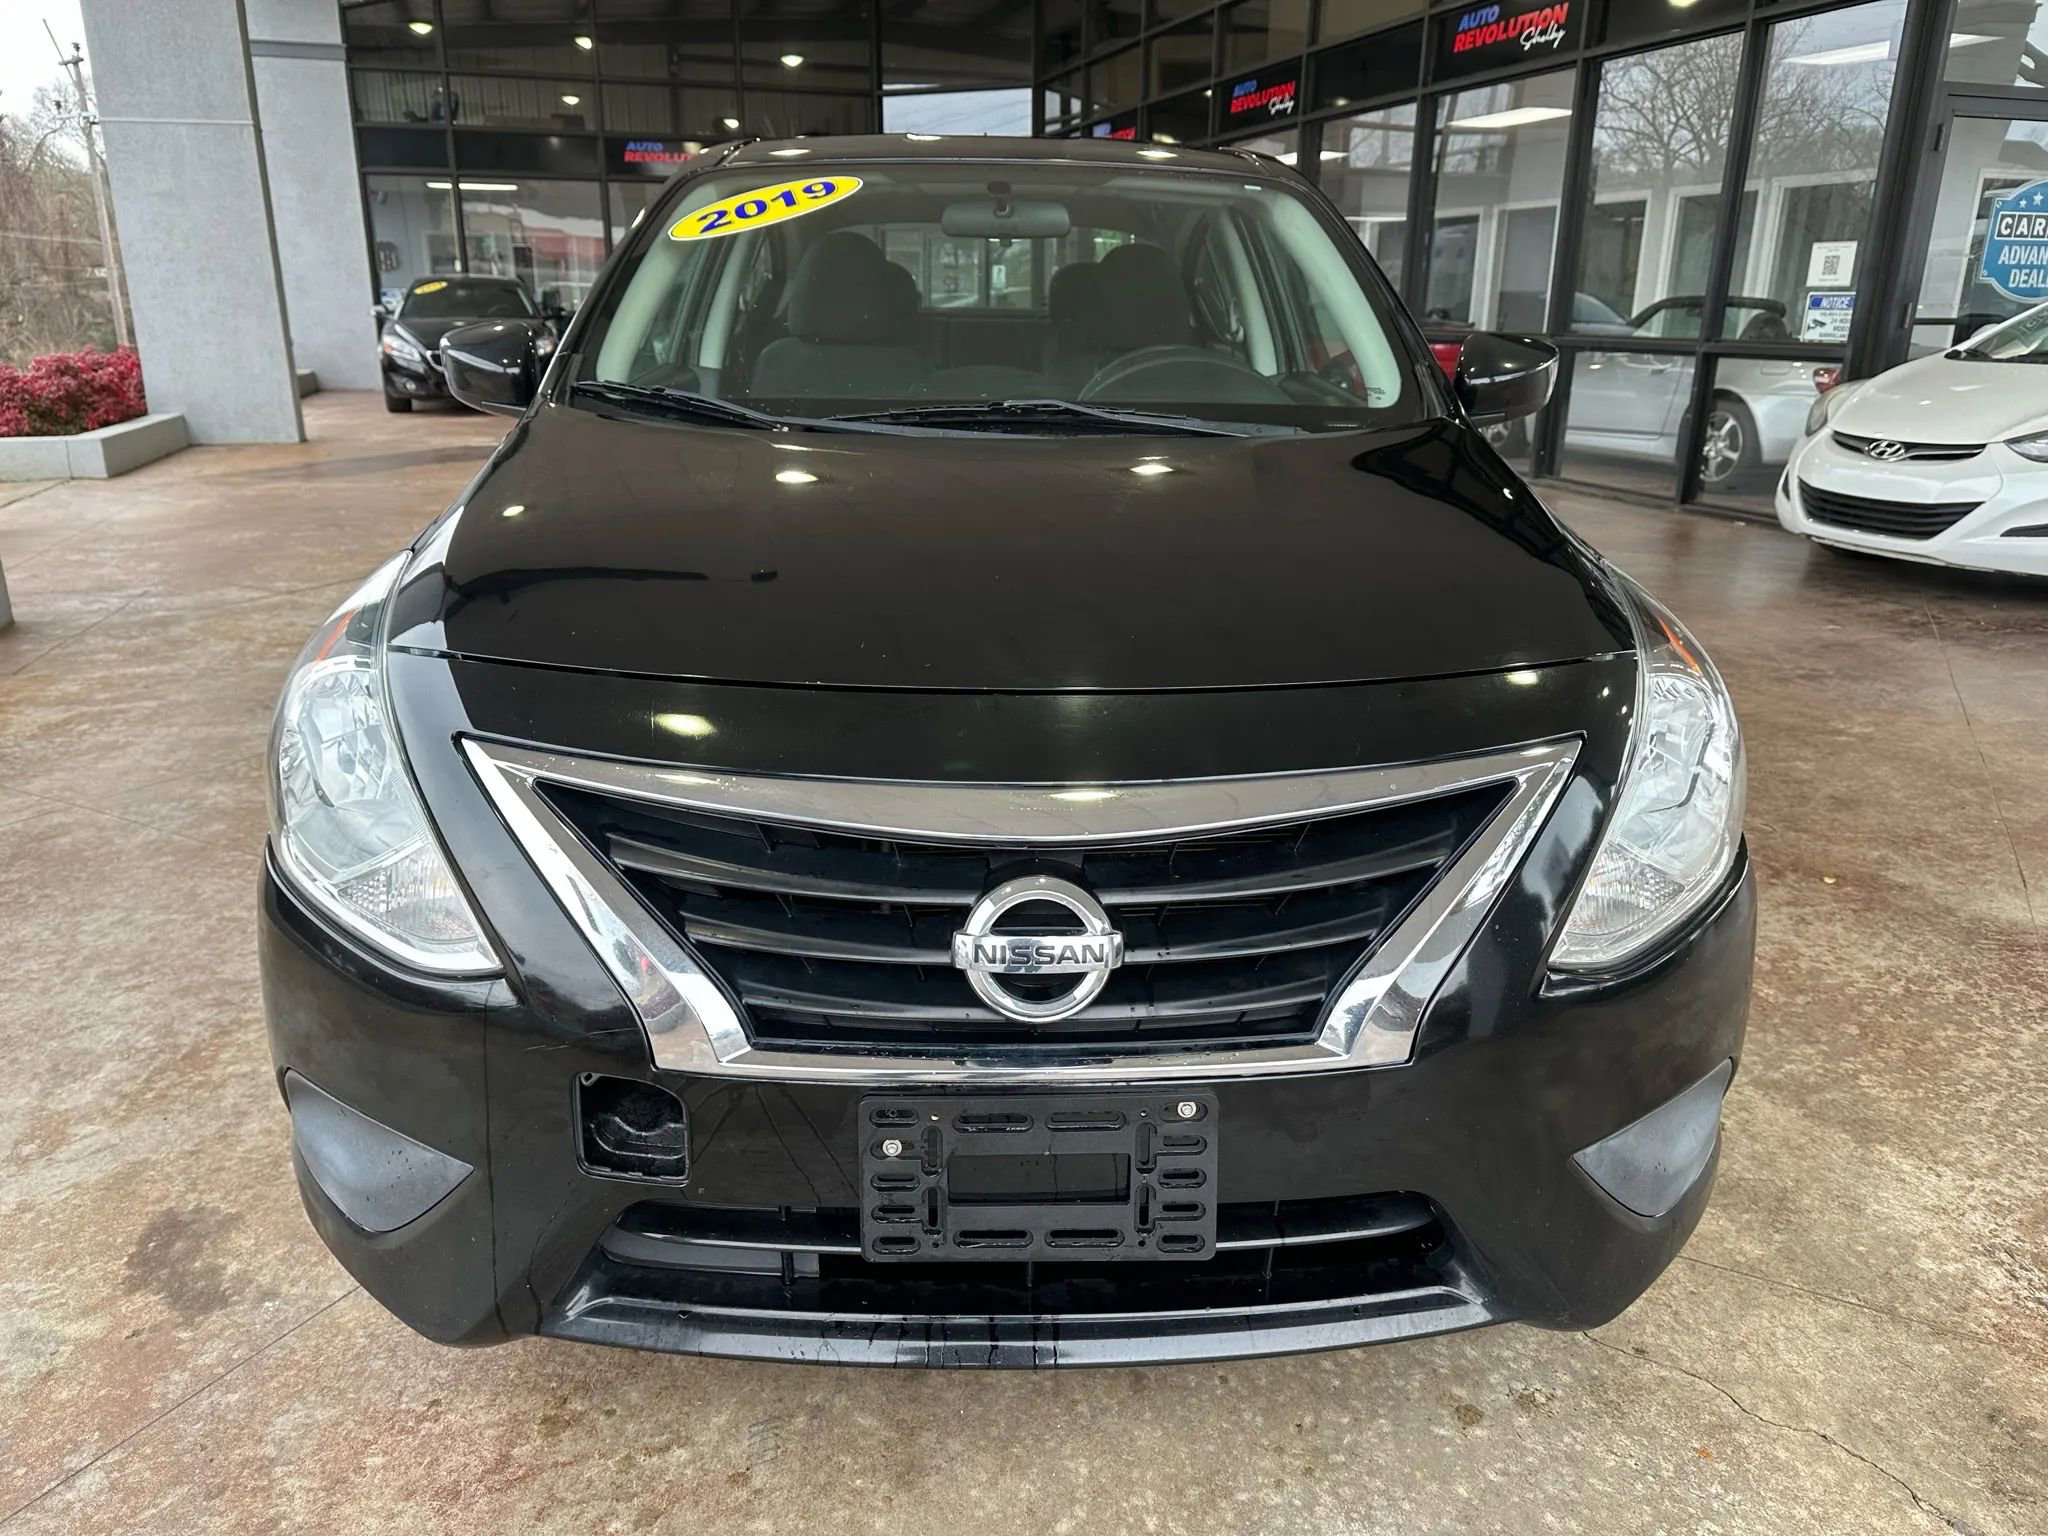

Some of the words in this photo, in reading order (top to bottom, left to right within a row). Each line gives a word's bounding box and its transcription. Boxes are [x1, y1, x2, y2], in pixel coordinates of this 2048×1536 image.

[1453, 2, 1569, 53] REVOLUTION
[1457, 4, 1500, 32] AUTO
[1519, 20, 1567, 51] Shelby
[1230, 80, 1296, 114] REVOLUTION
[1232, 79, 1257, 98] AUTO
[626, 141, 663, 151] AUTO
[696, 180, 838, 235] 2019
[2000, 216, 2048, 236] CAR
[2008, 268, 2048, 288] DEAL
[1820, 296, 1851, 308] NOTICE
[972, 943, 1105, 966] NISSAN
